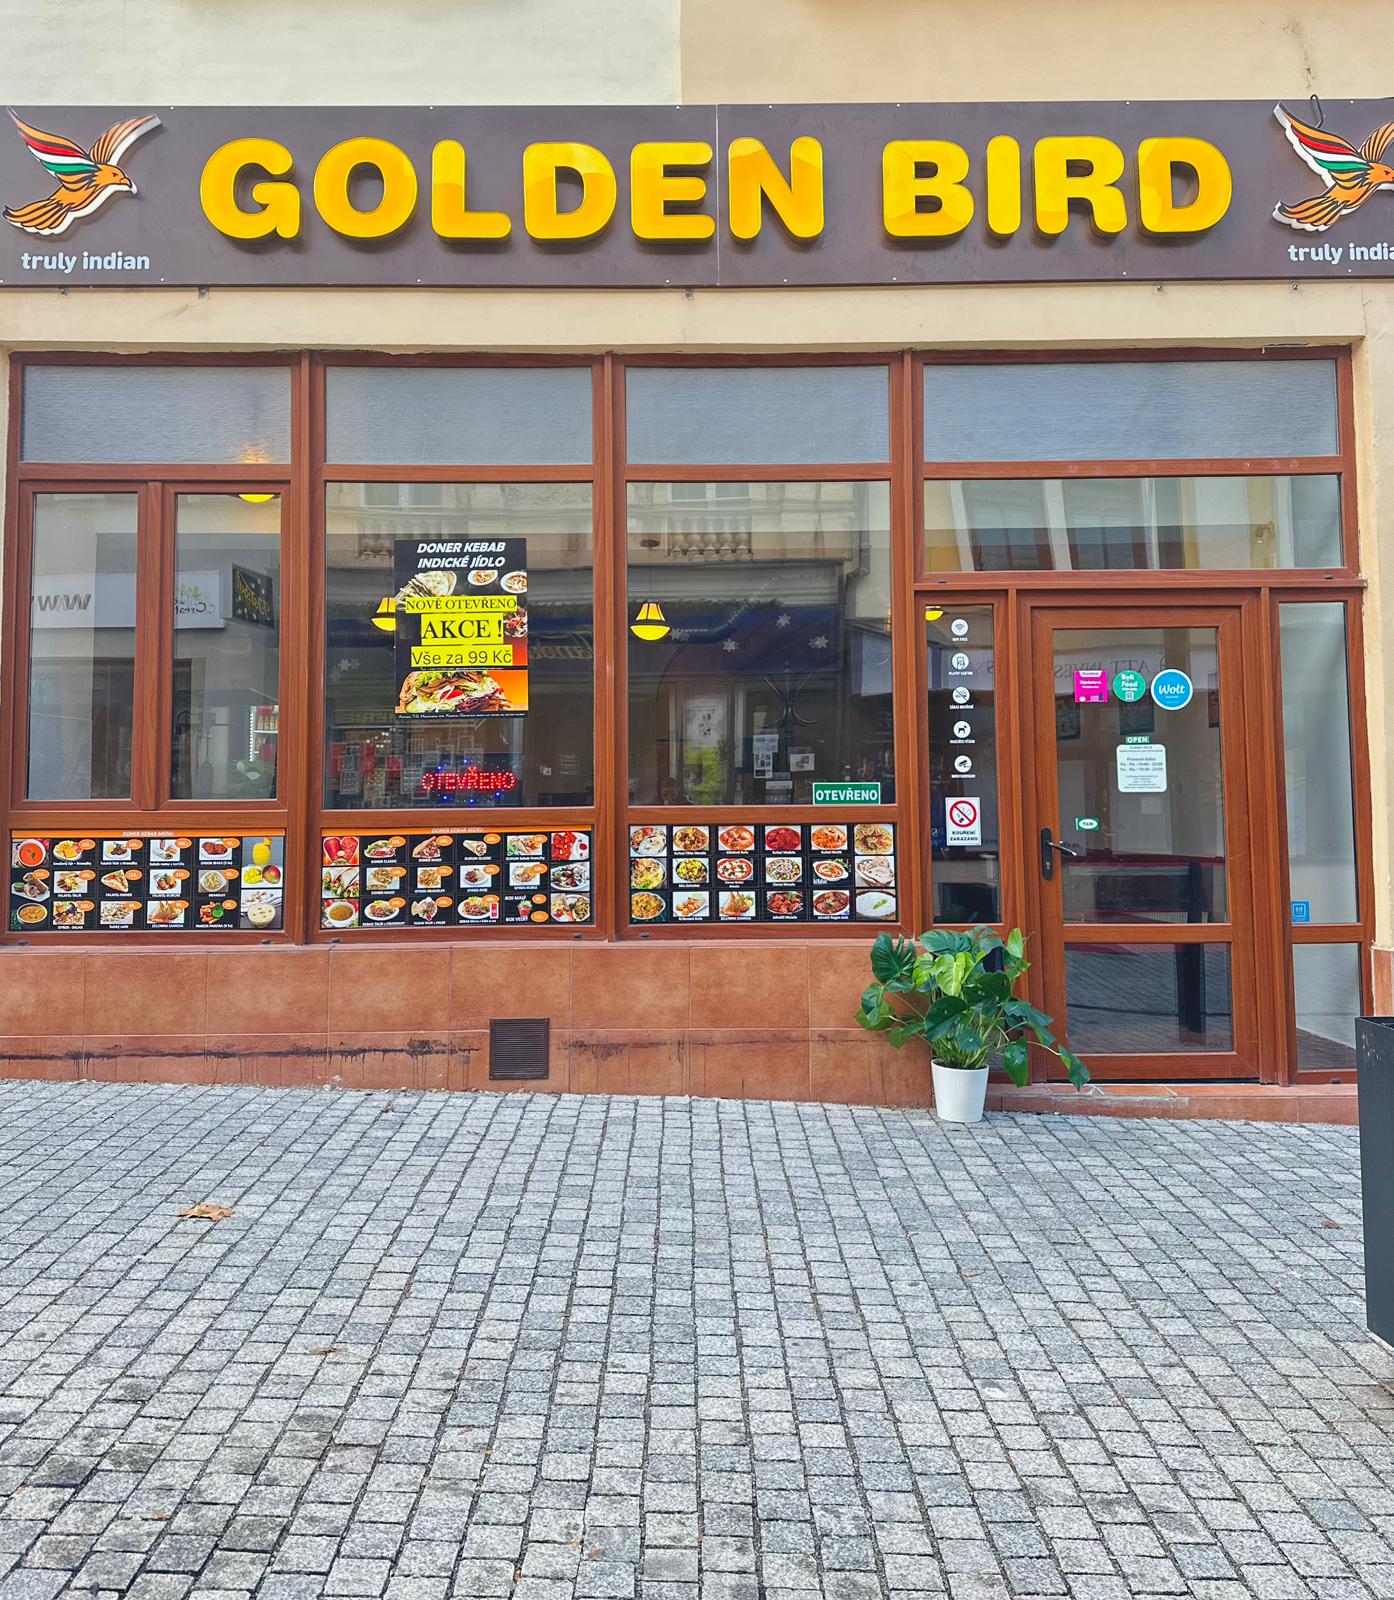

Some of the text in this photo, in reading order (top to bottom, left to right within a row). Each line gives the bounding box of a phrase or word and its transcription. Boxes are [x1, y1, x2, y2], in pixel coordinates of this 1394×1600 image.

[200, 134, 1233, 241] GOLDEN BIRD
[21, 250, 149, 274] truly indian
[1288, 244, 1343, 265] truly
[416, 542, 506, 554] DONER KEBAB
[417, 554, 506, 568] INDICKÉ JÍDLO
[446, 597, 516, 610] OTEVŘENO
[423, 619, 502, 639] AKCE !
[412, 649, 512, 666] Vše za 99 Kč
[1158, 684, 1186, 695] Wolt
[422, 766, 515, 790] OTEVŘENO
[815, 787, 878, 801] OTEVŘENO
